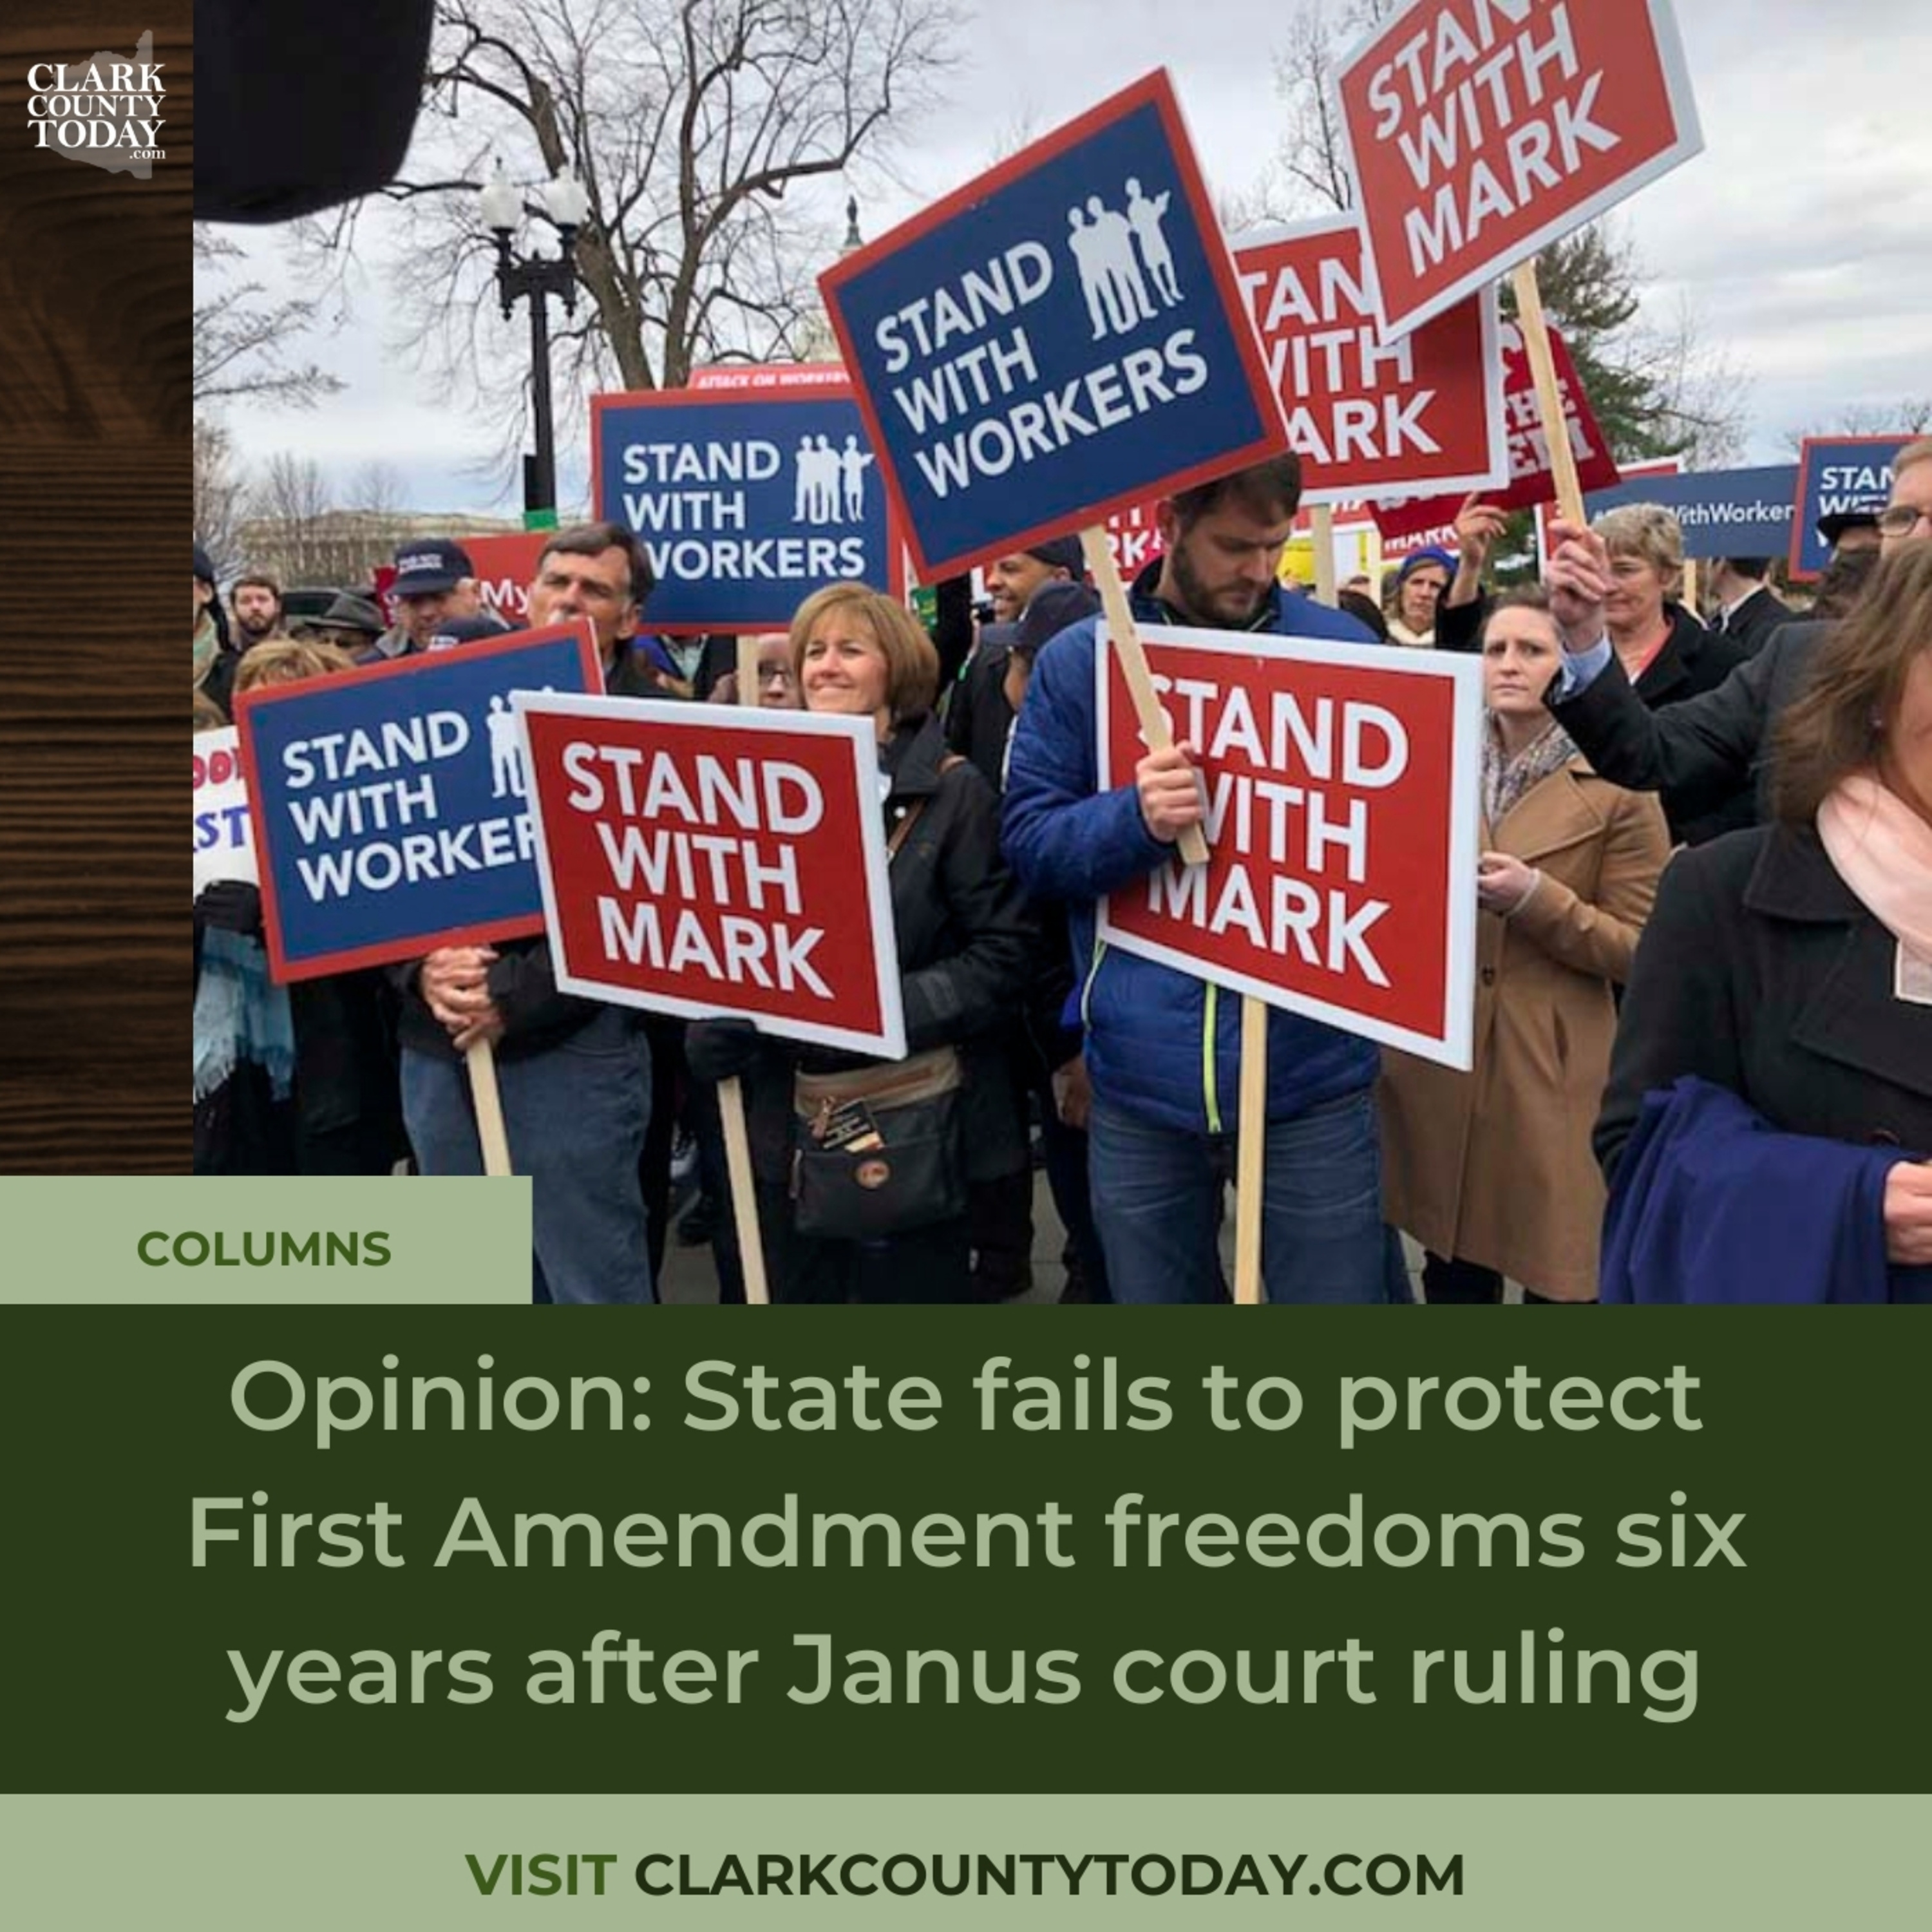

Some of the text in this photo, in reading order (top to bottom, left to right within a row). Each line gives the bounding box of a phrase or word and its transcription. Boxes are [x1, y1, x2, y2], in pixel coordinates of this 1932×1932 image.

[1398, 3, 1579, 190] WITH
[1403, 69, 1622, 278] MARK
[876, 241, 1054, 374] STAND
[893, 326, 1038, 435] WITH
[914, 328, 1208, 498] WORKERS
[623, 440, 781, 484] STAND
[623, 491, 745, 532] WITH
[480, 578, 530, 614] My
[283, 711, 469, 788] STAND
[562, 741, 824, 835] STAND
[289, 774, 437, 844] WITH
[595, 822, 804, 914] WITH
[597, 896, 835, 1000] MARK
[1148, 864, 1392, 989] MARK
